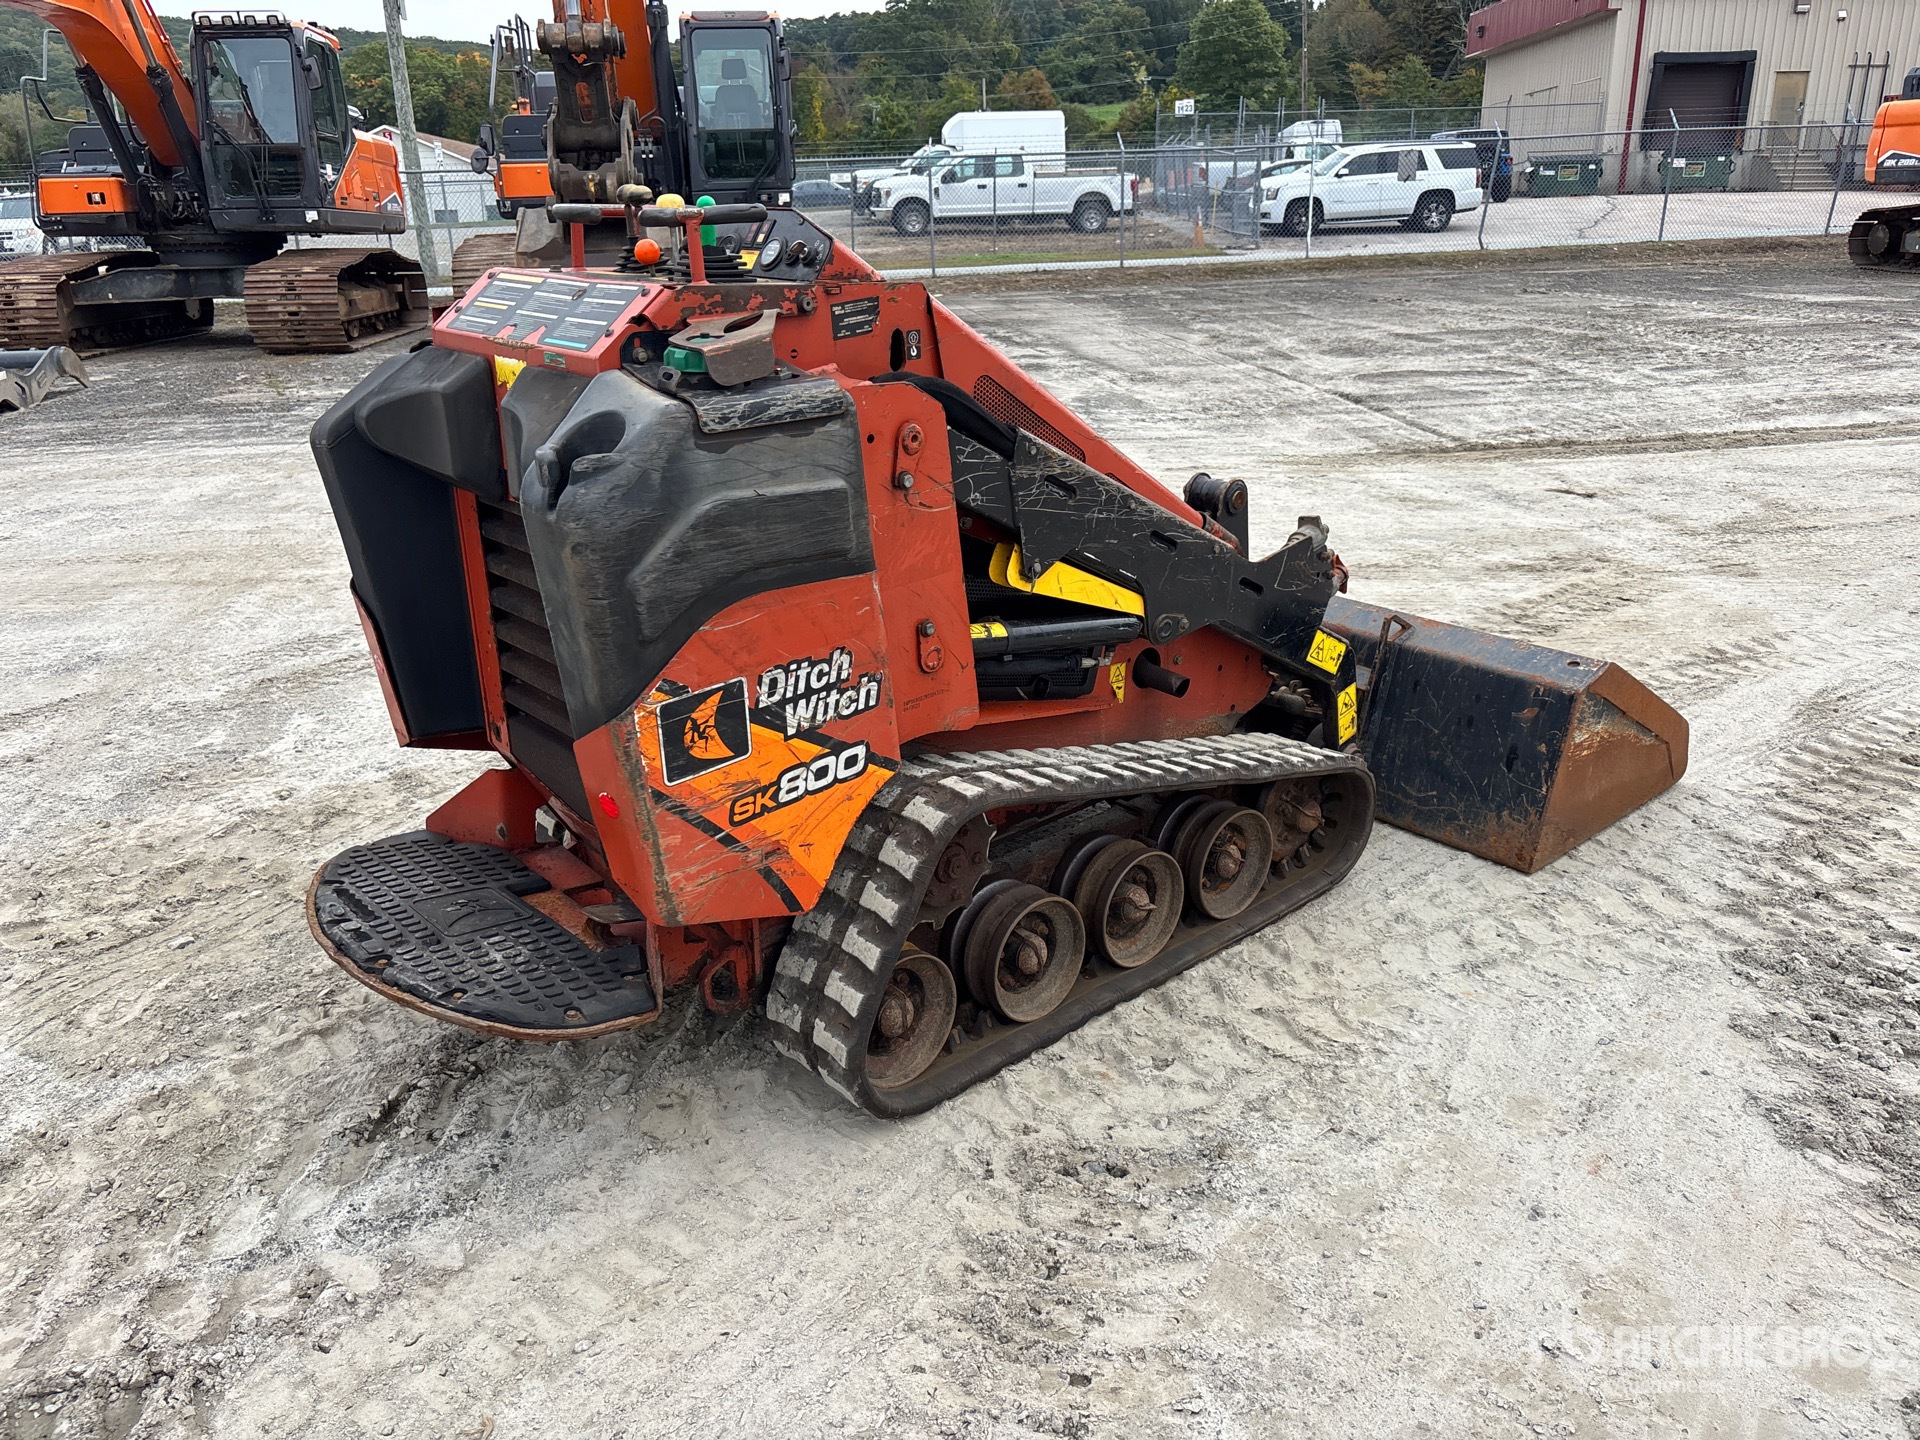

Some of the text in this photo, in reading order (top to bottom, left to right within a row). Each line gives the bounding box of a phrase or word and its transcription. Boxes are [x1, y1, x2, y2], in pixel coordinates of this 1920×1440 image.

[1185, 104, 1193, 112] 23
[758, 648, 853, 709] Ditch
[732, 743, 868, 823] SK800
